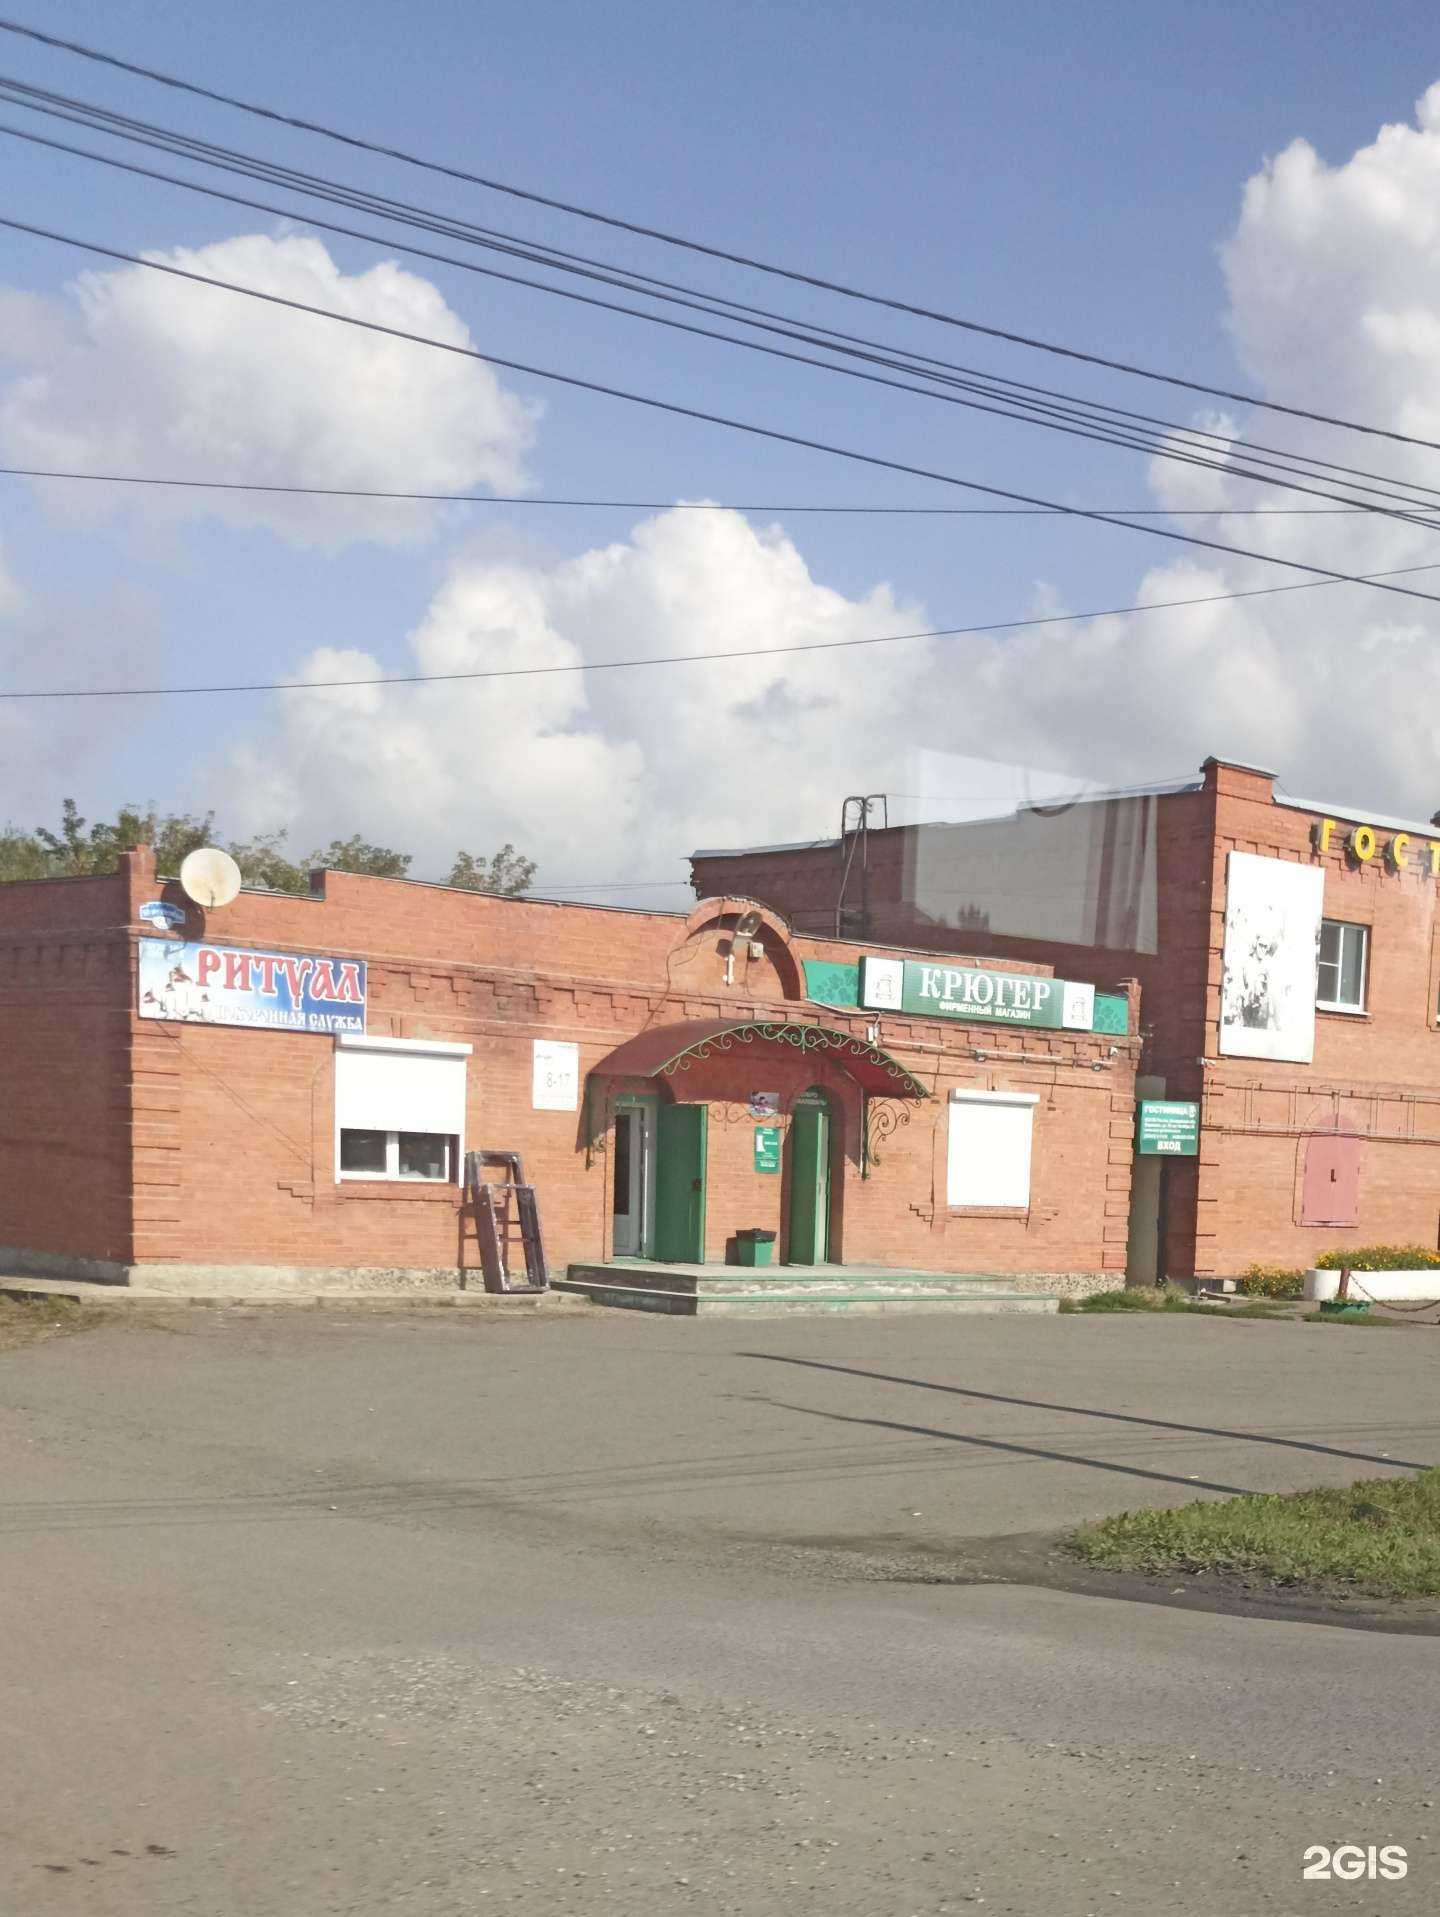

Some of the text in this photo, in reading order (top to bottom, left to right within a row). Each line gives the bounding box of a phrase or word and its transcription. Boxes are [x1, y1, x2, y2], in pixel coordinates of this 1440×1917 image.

[196, 949, 364, 1009] РИТУАЛ
[918, 967, 1050, 1011] КРЮГЕР
[939, 1001, 1031, 1020] ФИРМЕННЫЙ МАГАЗИН
[309, 1013, 363, 1031] СЛУЖБА
[1157, 1140, 1182, 1152] ВХОД
